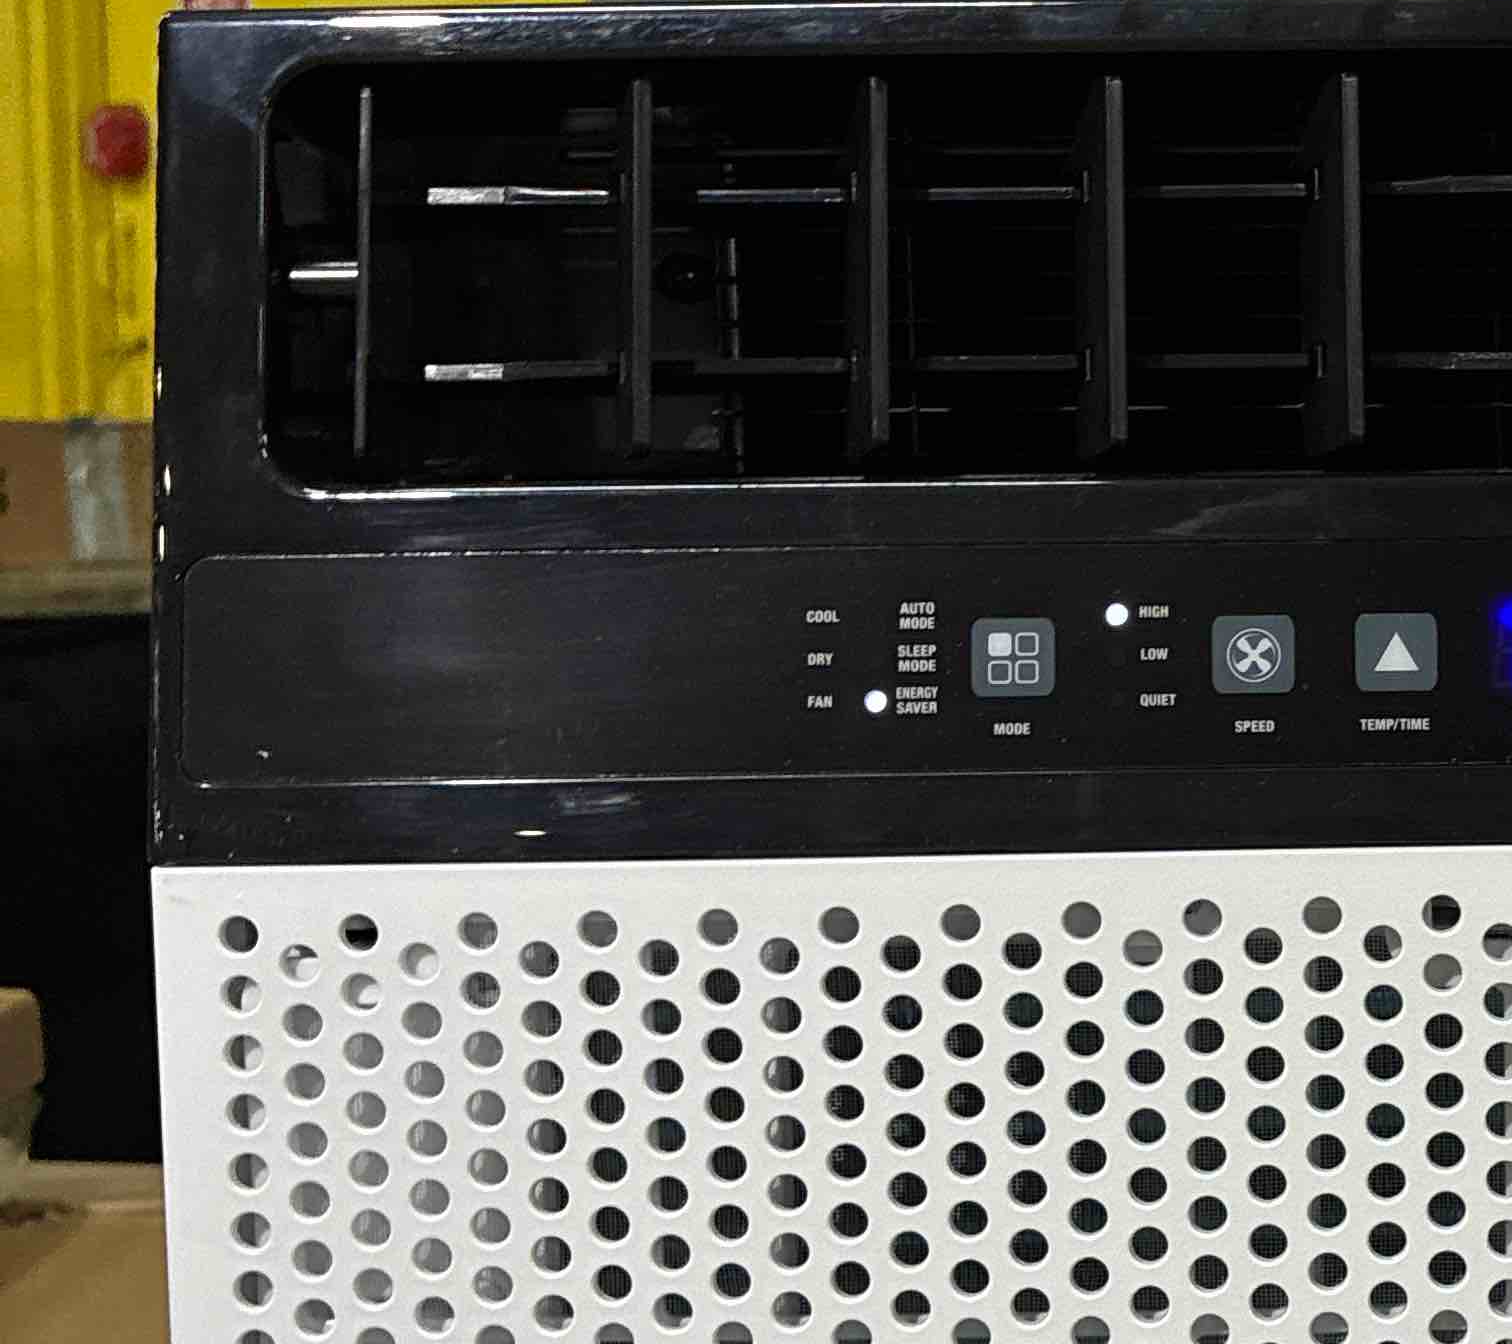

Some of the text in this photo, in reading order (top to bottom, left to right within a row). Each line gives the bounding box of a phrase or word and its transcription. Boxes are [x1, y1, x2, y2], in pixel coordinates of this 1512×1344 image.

[899, 601, 935, 615] AUTO
[1138, 605, 1169, 618] HIGH
[805, 609, 841, 624] COOL
[899, 616, 935, 630] MODE
[897, 644, 937, 658] SLEEP
[1140, 647, 1169, 661] LOW
[807, 652, 834, 666] DRY
[897, 659, 937, 673] MODE
[895, 686, 939, 700] ENERGY
[1139, 693, 1177, 707] QUIET
[807, 695, 833, 709] FAN
[895, 700, 938, 715] SAVER
[993, 722, 1031, 736] MODE
[1234, 719, 1275, 733] SPEED
[1359, 717, 1430, 731] TEMP/TIME
